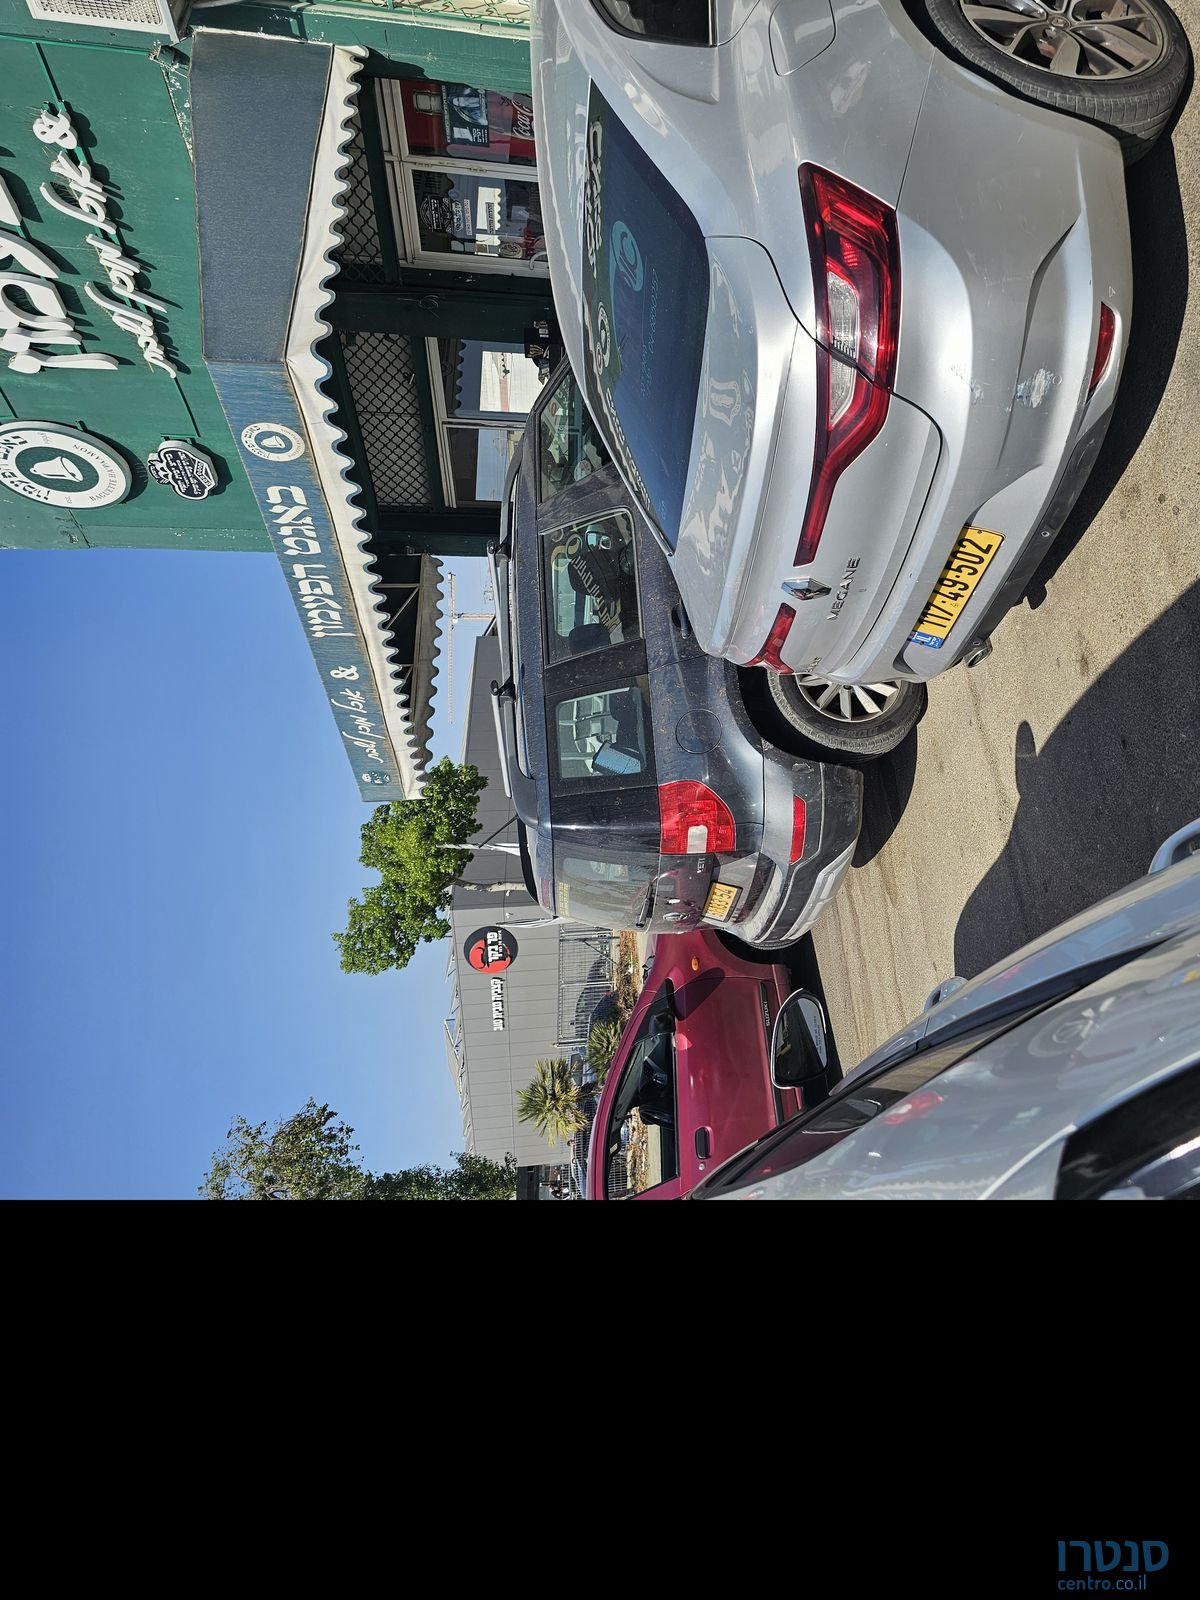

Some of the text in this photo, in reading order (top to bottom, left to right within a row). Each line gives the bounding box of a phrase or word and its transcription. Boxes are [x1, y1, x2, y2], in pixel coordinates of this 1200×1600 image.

[32, 109, 177, 378] & אוכל מוכן לשבת
[265, 485, 322, 556] באגט
[291, 564, 356, 638] הפעמון
[826, 556, 860, 620] MEGANE
[330, 664, 360, 680] &
[330, 688, 367, 714] אוכל
[350, 714, 386, 740] מוכן
[342, 732, 384, 764] לשבת
[486, 932, 503, 962] פר בקר
[492, 1002, 504, 1018] מבית
[492, 1019, 504, 1031] טוב
